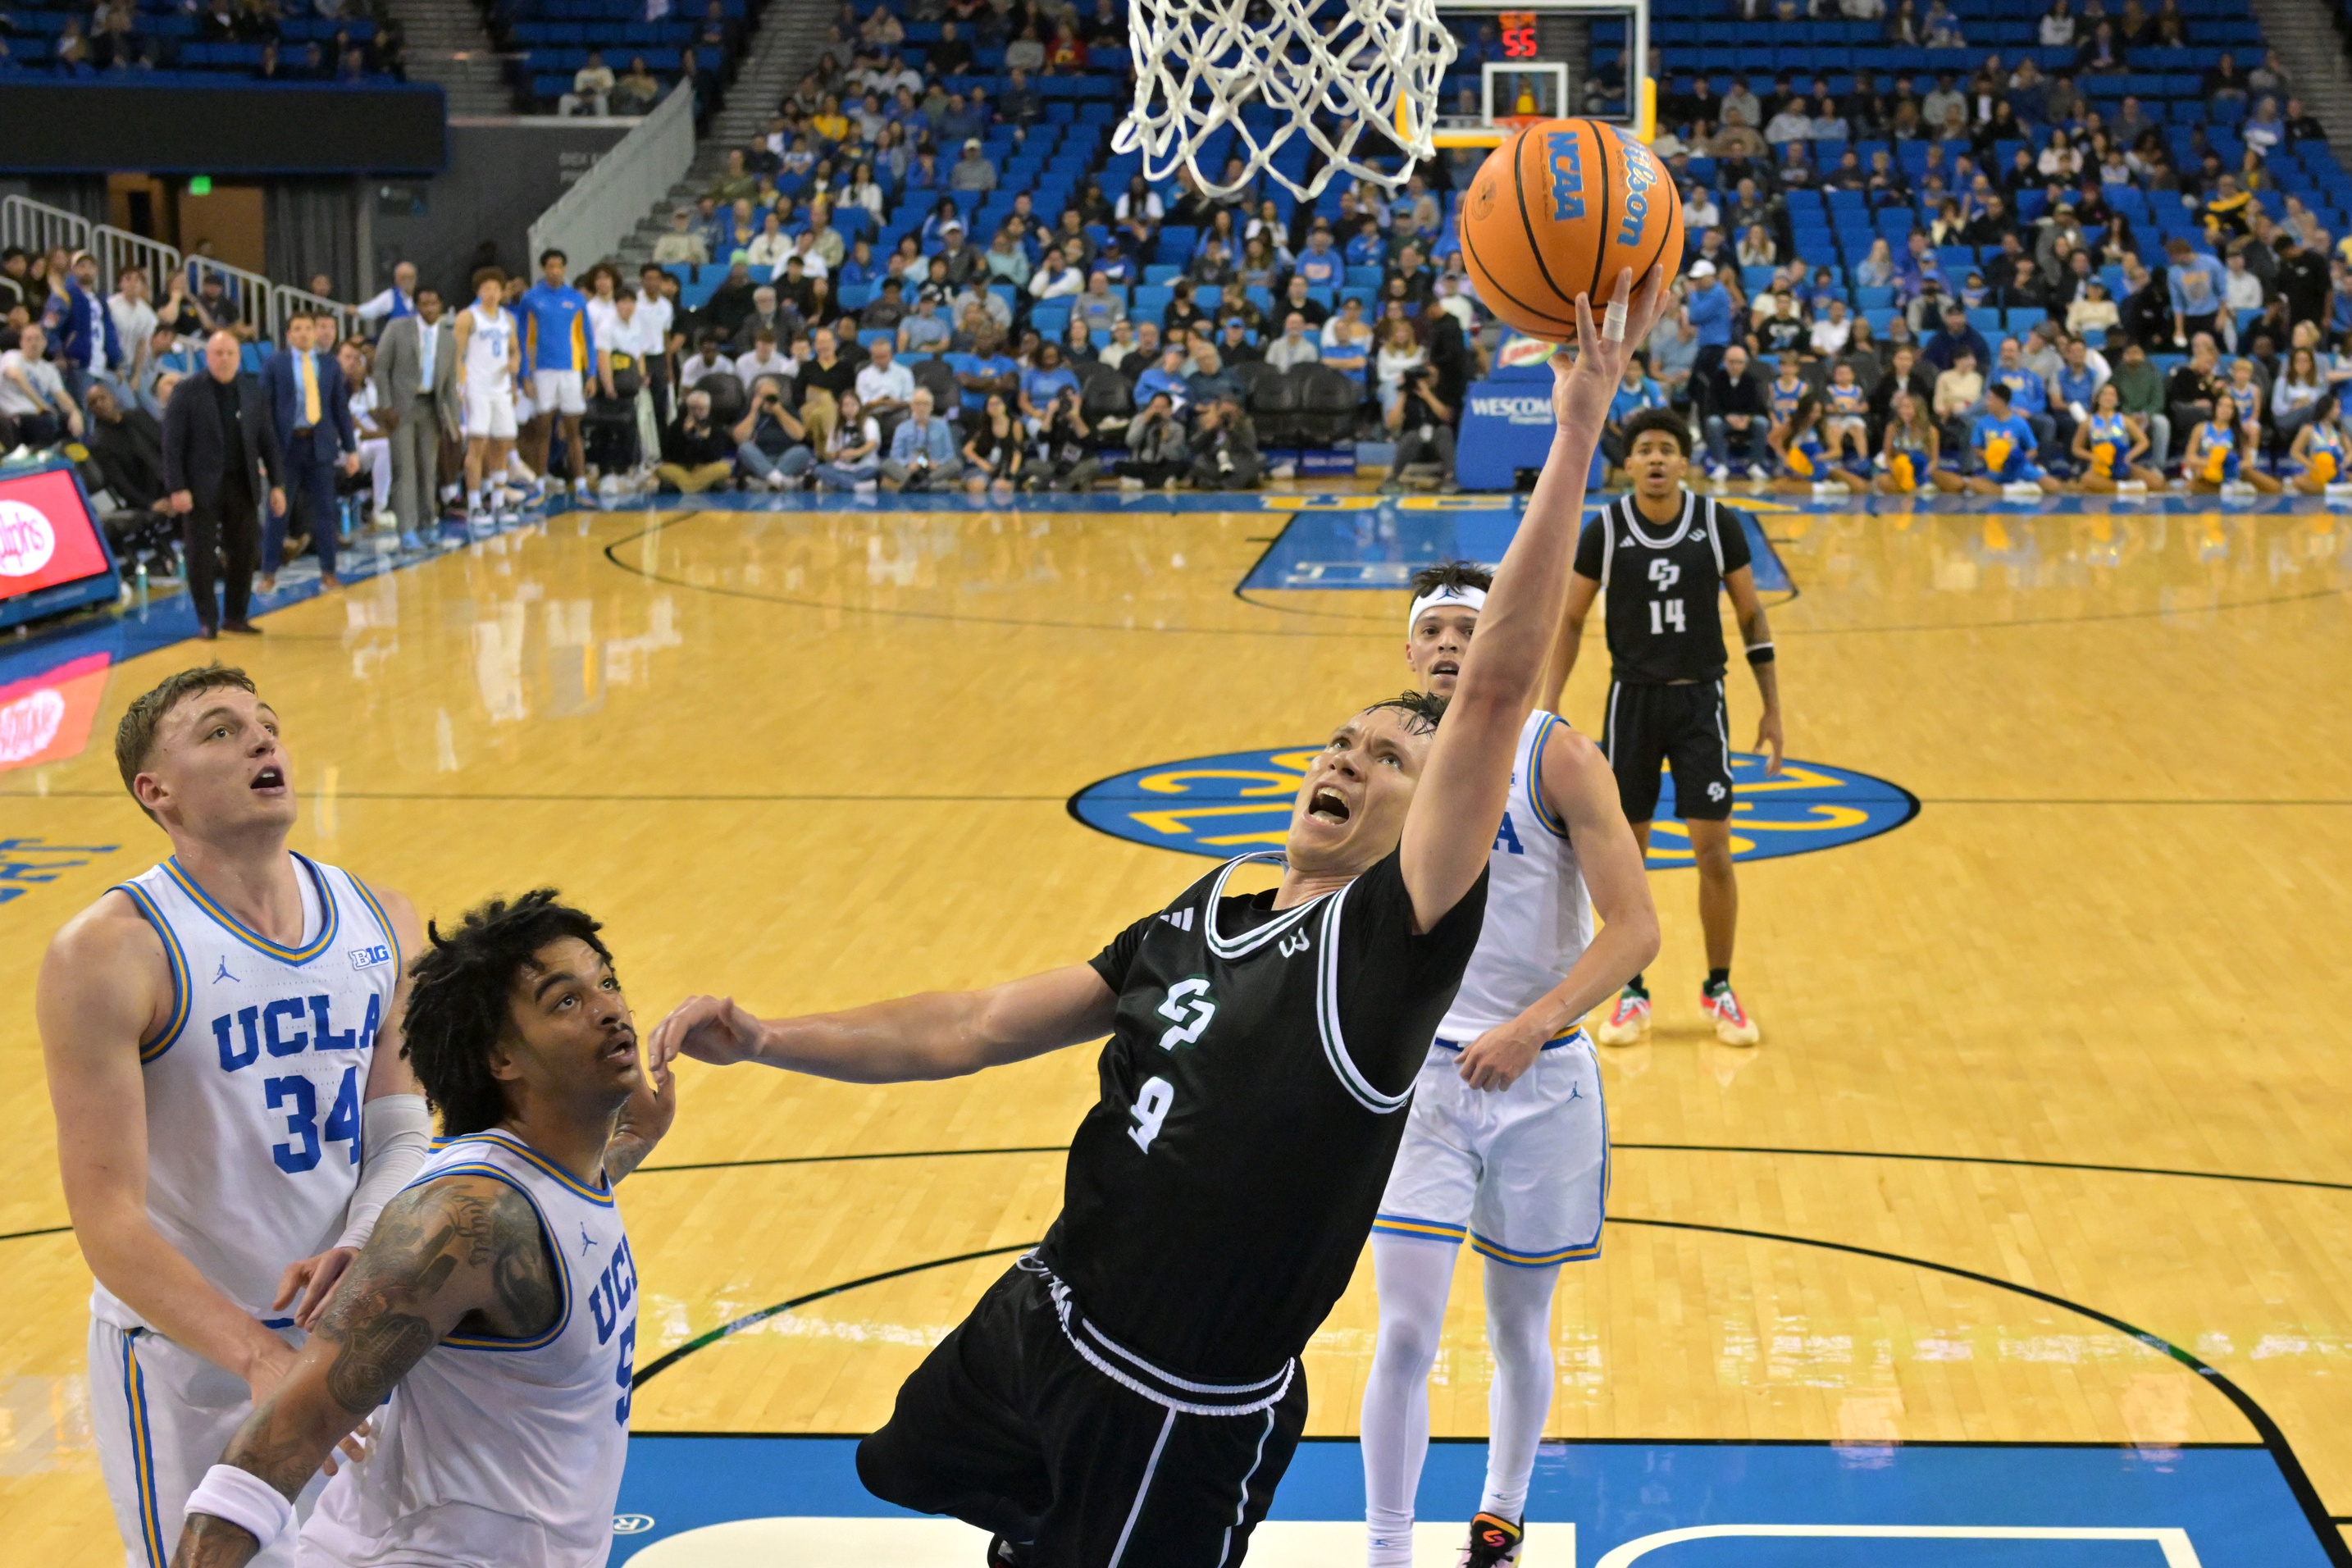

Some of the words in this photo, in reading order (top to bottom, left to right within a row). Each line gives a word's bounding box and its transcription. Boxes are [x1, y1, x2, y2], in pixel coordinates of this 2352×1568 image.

[1547, 132, 1585, 221] NCAA
[1648, 598, 1686, 635] 14
[212, 993, 380, 1073] UCLA
[264, 1066, 360, 1174] 34
[1127, 1076, 1174, 1155] 9
